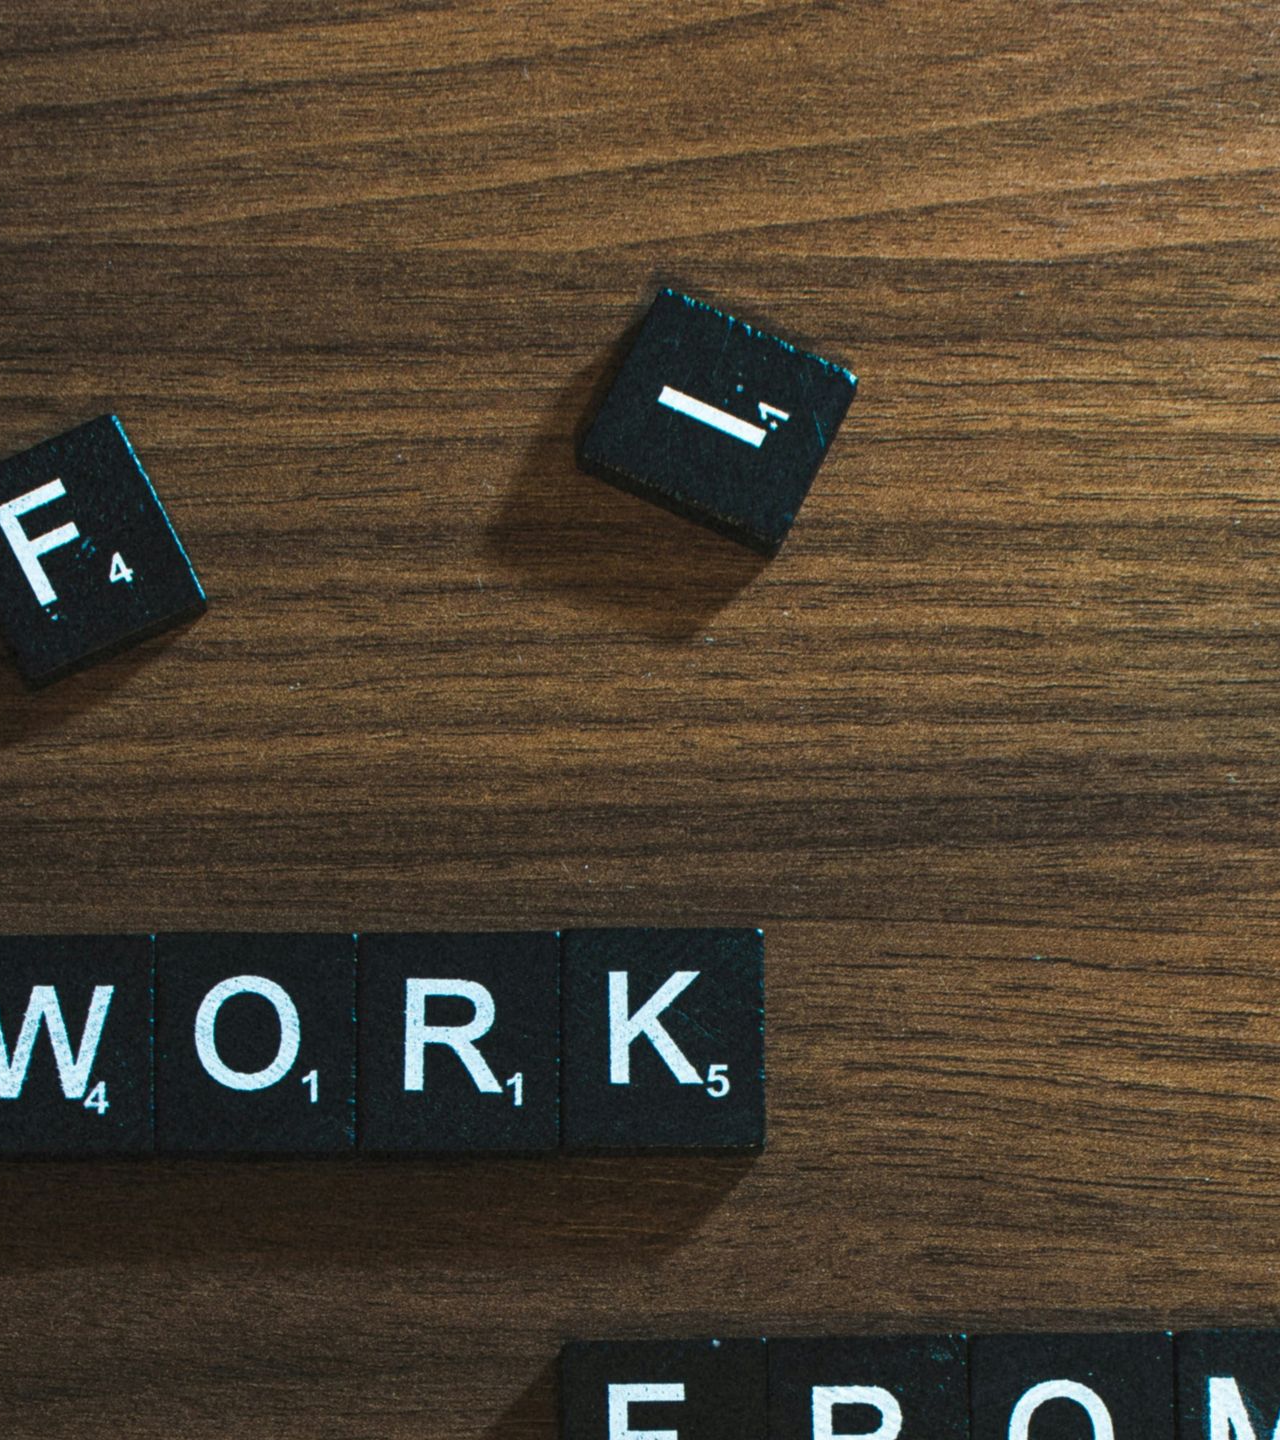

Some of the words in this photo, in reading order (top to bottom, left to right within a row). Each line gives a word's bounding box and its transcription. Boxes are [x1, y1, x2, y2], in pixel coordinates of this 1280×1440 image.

[658, 386, 767, 446] I
[759, 401, 790, 421] 1
[109, 552, 133, 582] 4
[84, 1080, 108, 1113] 4
[302, 1070, 317, 1103] 1
[506, 1072, 522, 1105] 1
[707, 1064, 730, 1097] 5
